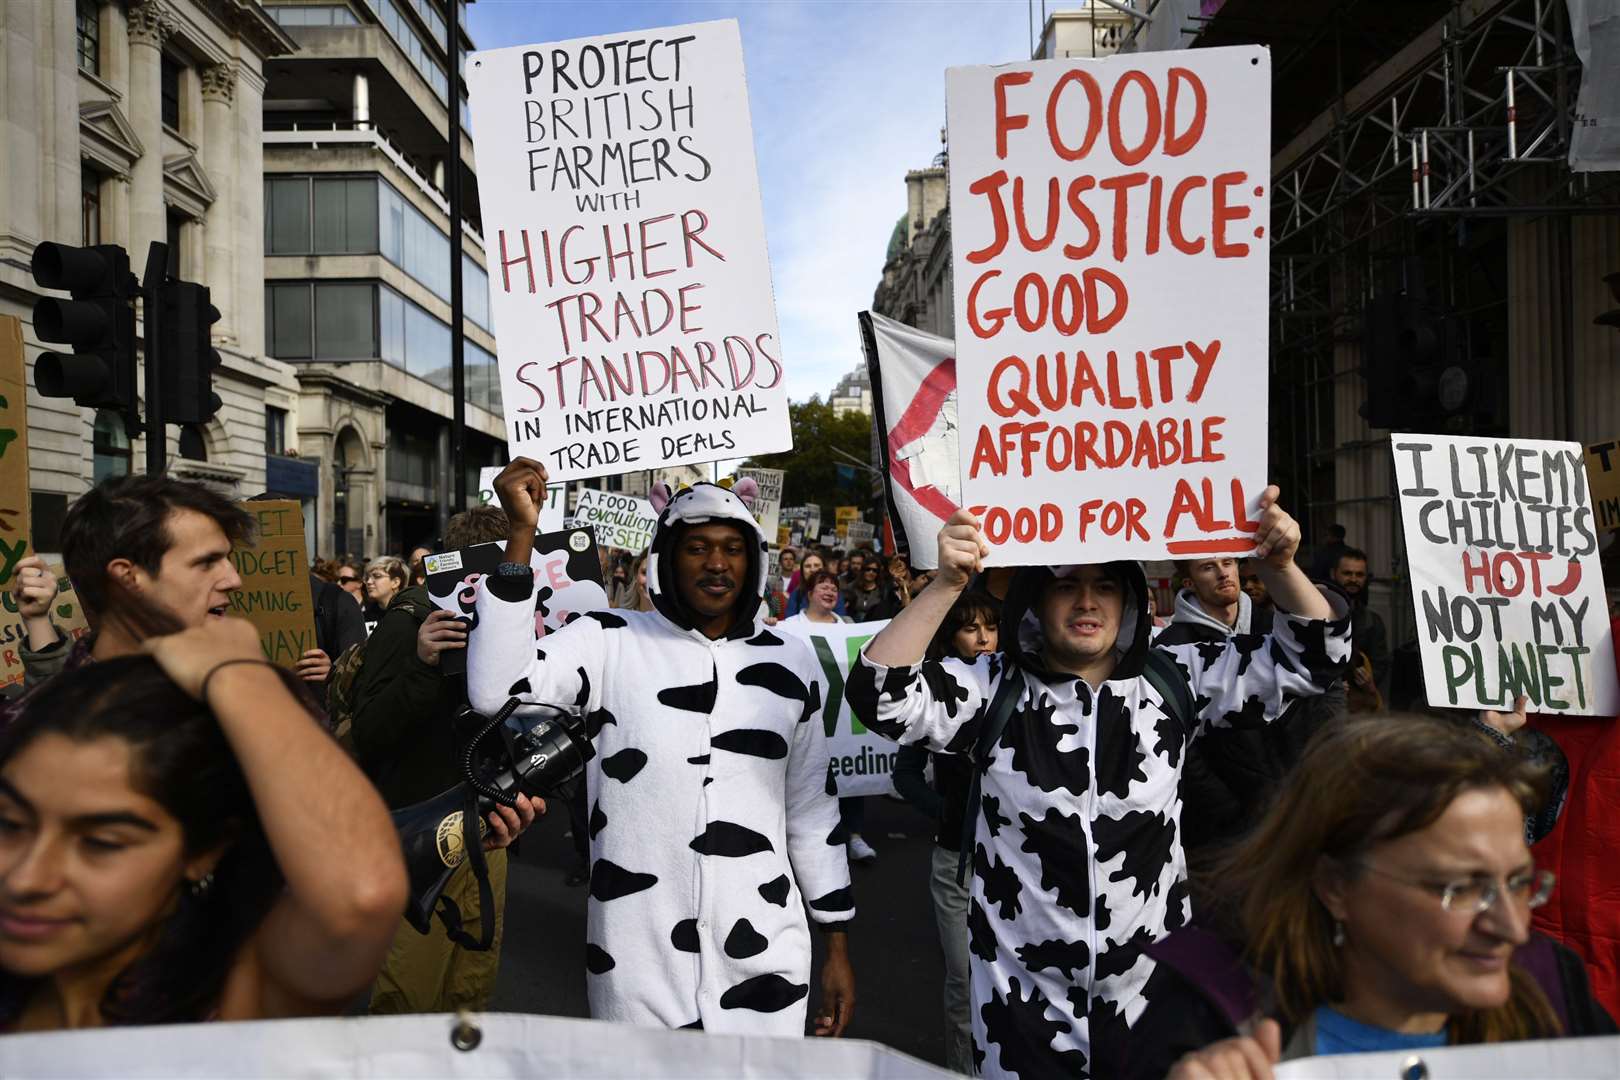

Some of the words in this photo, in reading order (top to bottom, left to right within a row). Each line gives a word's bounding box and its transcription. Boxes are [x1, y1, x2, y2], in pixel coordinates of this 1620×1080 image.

[523, 35, 696, 94] PROTECT
[525, 86, 694, 143] BRITISH
[994, 67, 1208, 166] FOOD
[528, 136, 711, 191] FARMERS
[576, 190, 640, 212] WITH
[966, 170, 1265, 264] JUSTICE:
[499, 209, 727, 294] HIGHER
[545, 283, 705, 355] TRADE
[967, 267, 1129, 339] GOOD
[516, 333, 783, 413] STANDARDS
[987, 339, 1222, 417] QUALITY
[514, 417, 541, 442] IN
[566, 393, 767, 436] INTERNATIONAL
[550, 439, 641, 470] TRADE
[662, 431, 735, 460] DEALS
[969, 416, 1226, 480] AFFORDABLE
[1396, 443, 1439, 497] I
[575, 504, 656, 533] revolution
[581, 491, 592, 504] A
[598, 493, 637, 512] FOOD
[1079, 498, 1151, 543] FOR
[1163, 477, 1260, 538] ALL
[1419, 500, 1596, 556] CHILLIES
[1462, 551, 1553, 597] HOT
[1422, 586, 1510, 643] NOT
[1531, 597, 1590, 648] MY
[1442, 642, 1590, 710] PLANET
